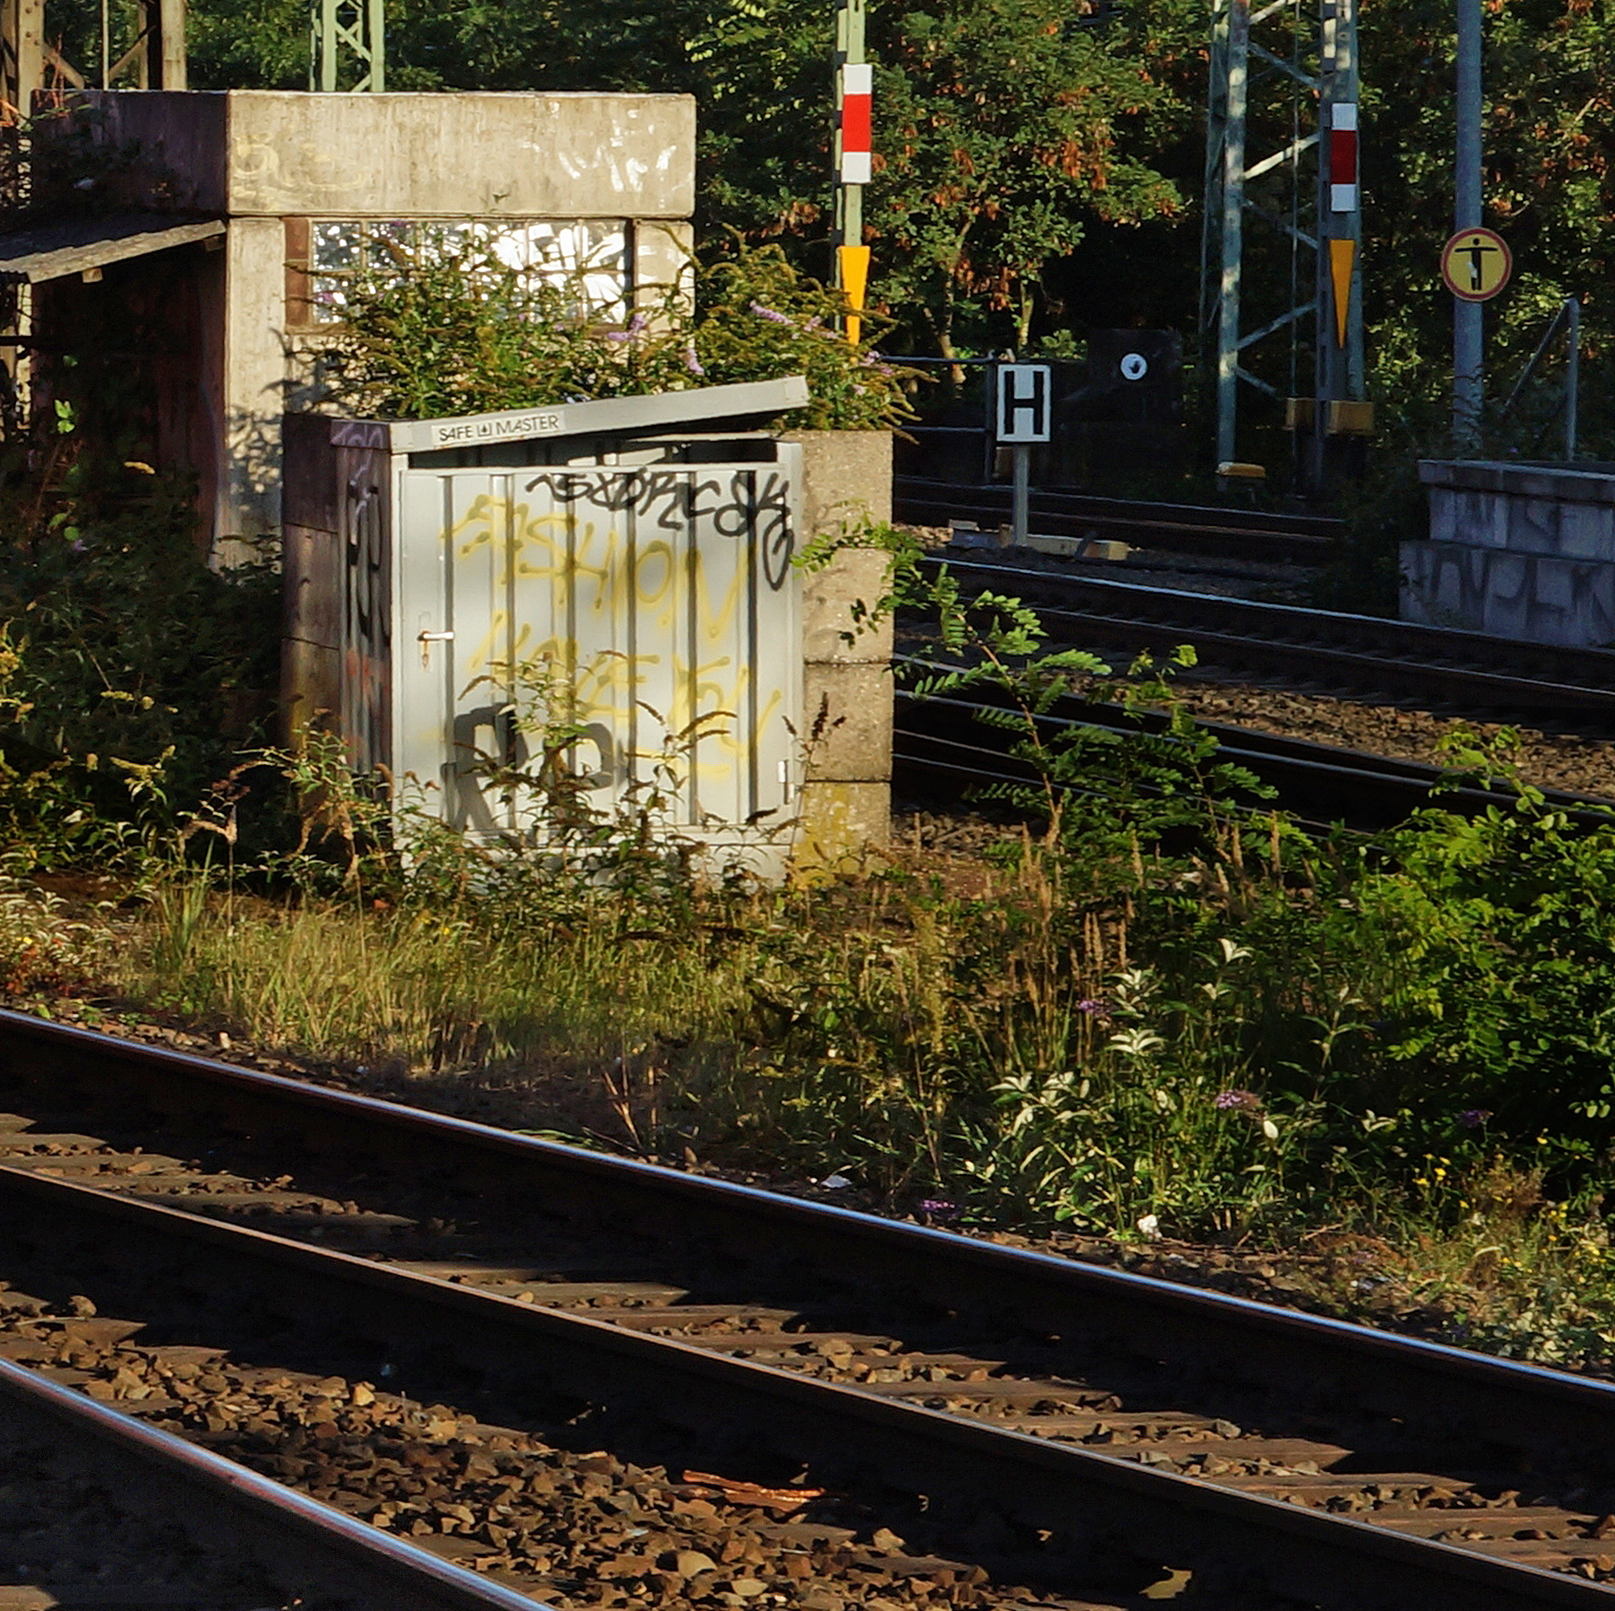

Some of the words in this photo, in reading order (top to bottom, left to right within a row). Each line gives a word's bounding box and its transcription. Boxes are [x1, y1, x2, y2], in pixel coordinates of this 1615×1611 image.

[1003, 370, 1045, 436] H
[438, 424, 473, 442] SAFE
[496, 414, 559, 435] MASTER
